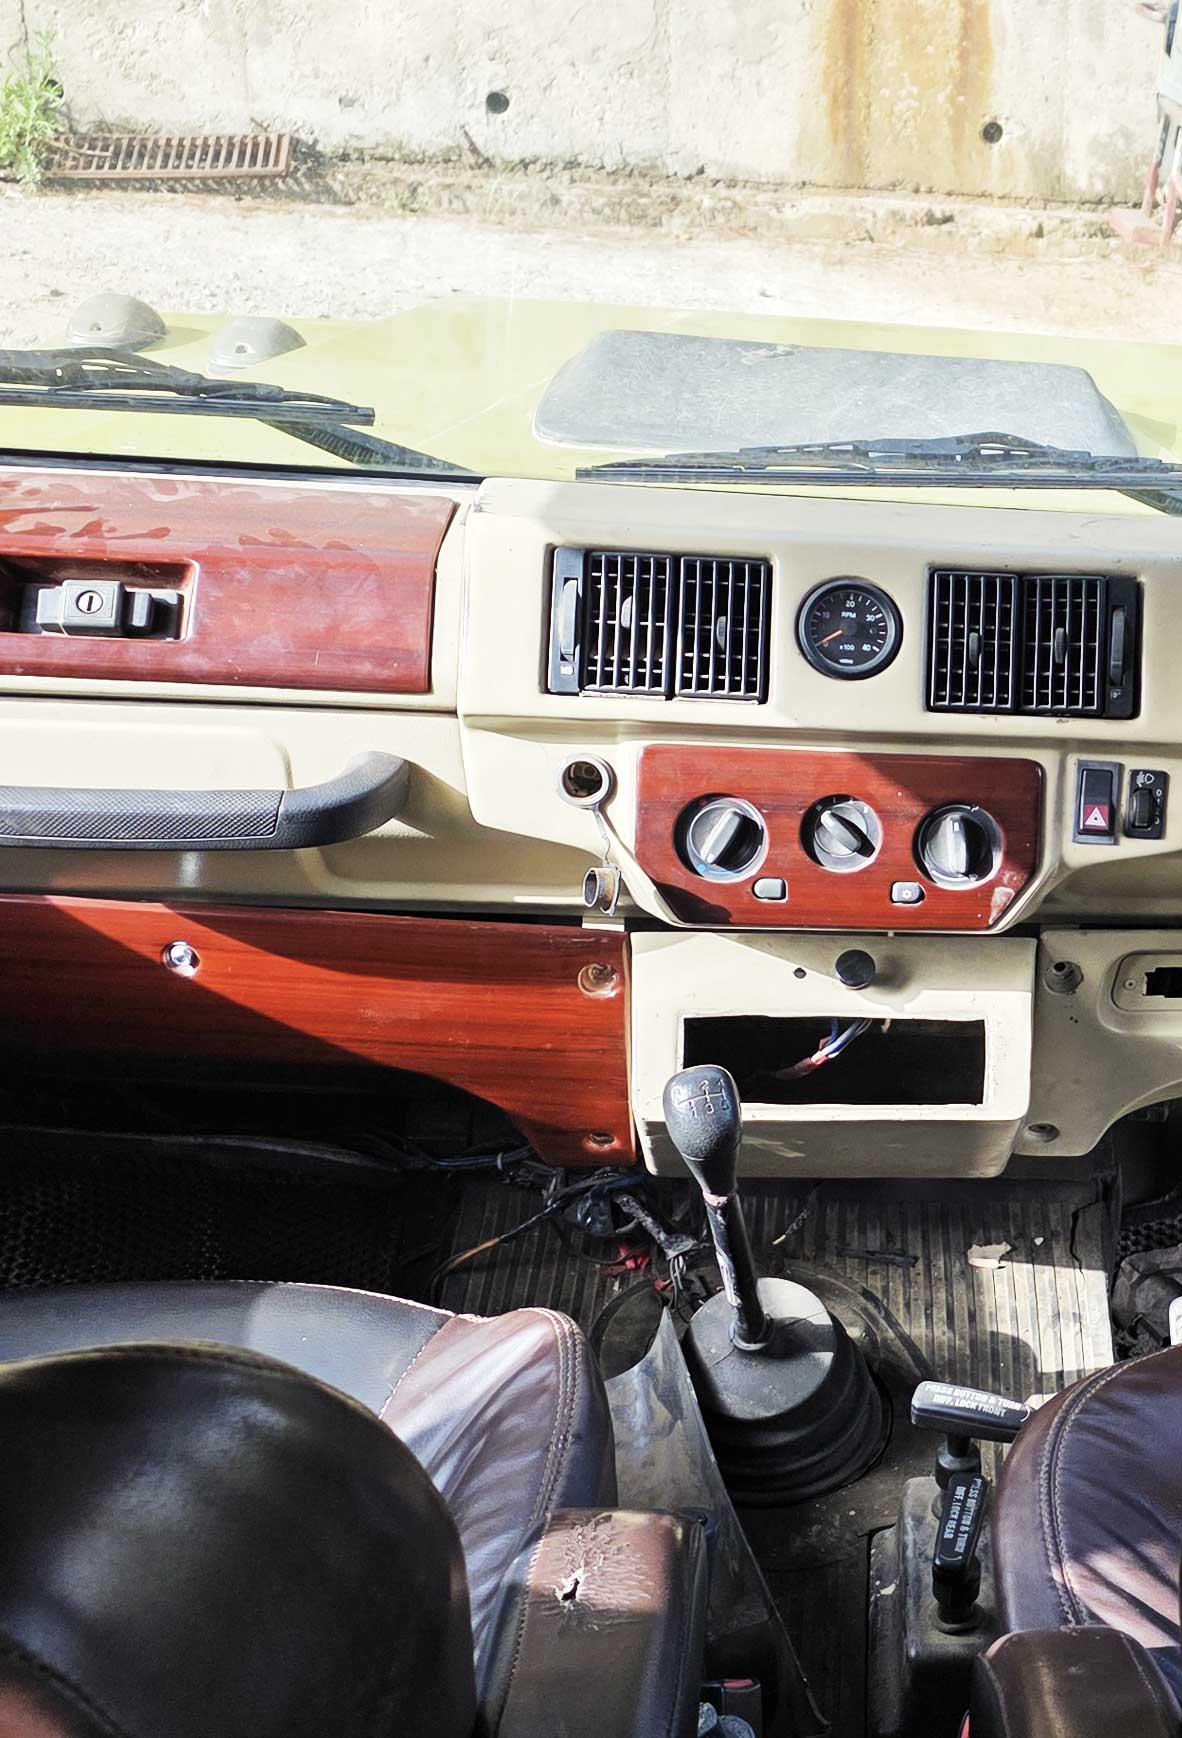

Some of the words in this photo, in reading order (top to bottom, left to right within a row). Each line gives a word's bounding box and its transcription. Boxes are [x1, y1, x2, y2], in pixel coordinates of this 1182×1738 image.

[865, 614, 875, 622] 30
[862, 643, 871, 651] 40
[699, 1080, 709, 1090] 2
[704, 1102, 715, 1114] 3
[925, 1383, 954, 1397] PRESS
[953, 1389, 989, 1403] BUTTON
[988, 1396, 996, 1404] &
[998, 1397, 1022, 1411] TURN
[933, 1394, 954, 1406] DIFF.
[954, 1398, 978, 1410] LOCK
[978, 1402, 1007, 1418] FRONT
[962, 1498, 977, 1526] BUTTON
[944, 1519, 957, 1538] REAR
[954, 1533, 969, 1553] TURN
